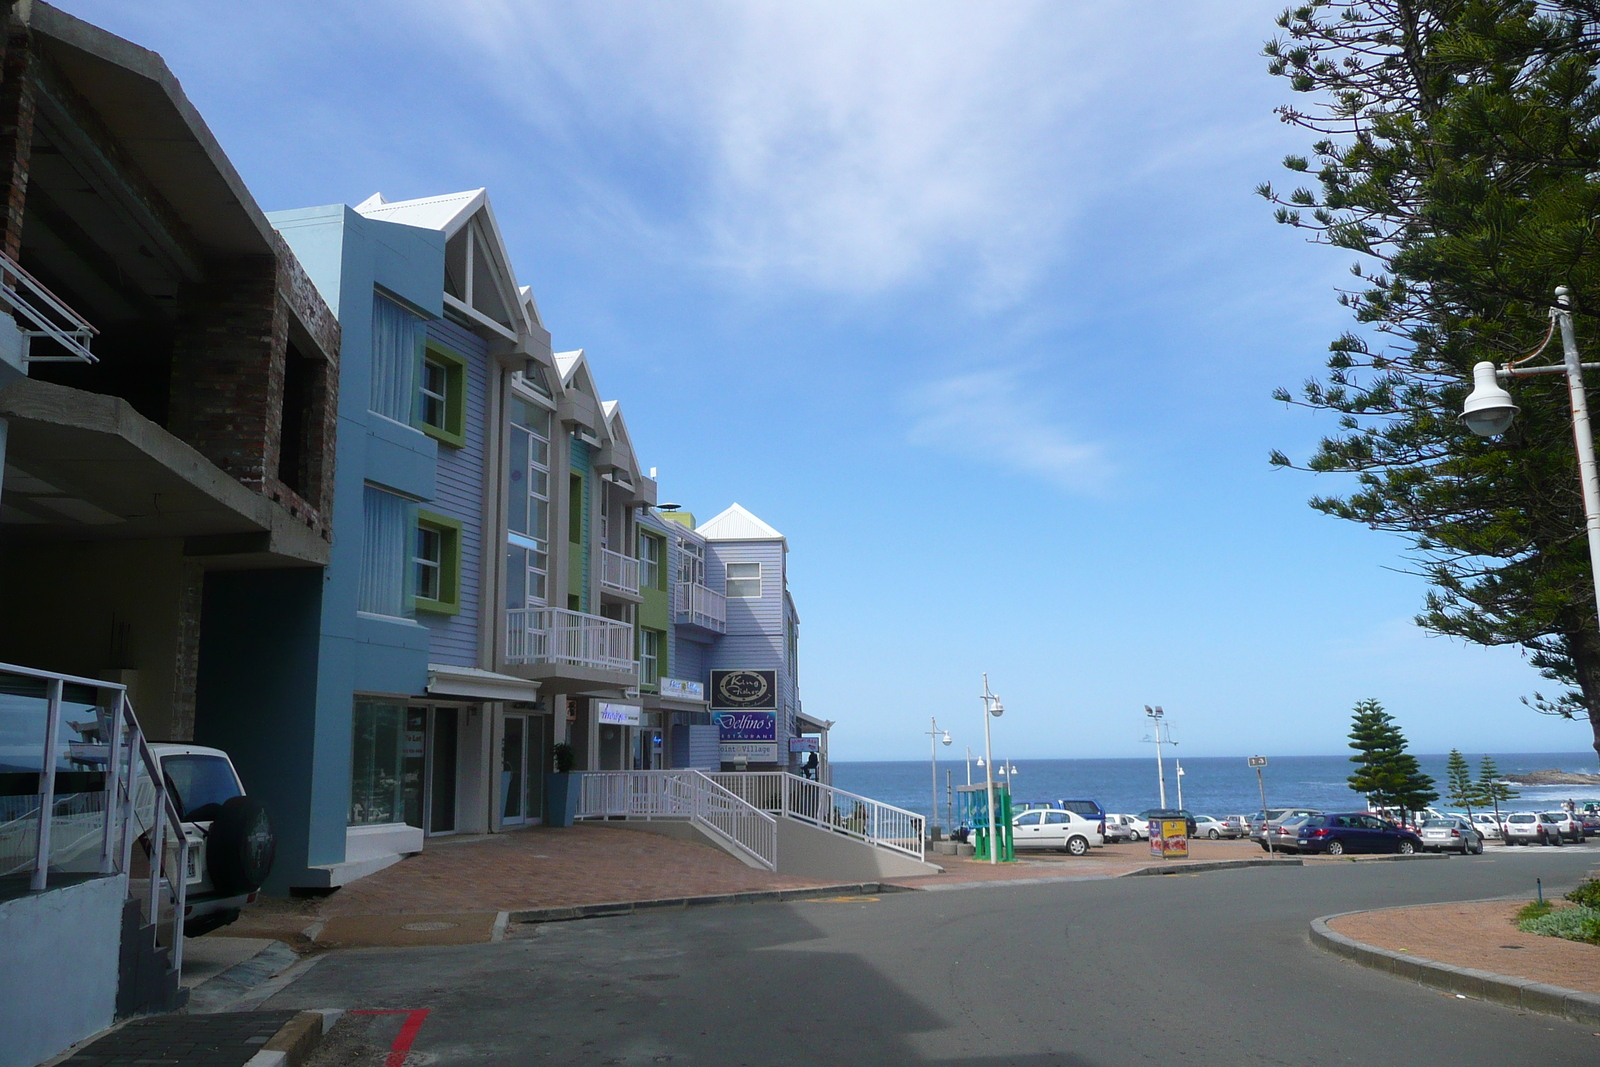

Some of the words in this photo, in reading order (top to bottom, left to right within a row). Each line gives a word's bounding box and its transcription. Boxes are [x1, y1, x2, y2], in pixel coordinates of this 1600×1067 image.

[731, 676, 759, 687] King
[726, 685, 759, 696] Fisher
[714, 714, 773, 734] Delfino's
[742, 745, 770, 753] Village
